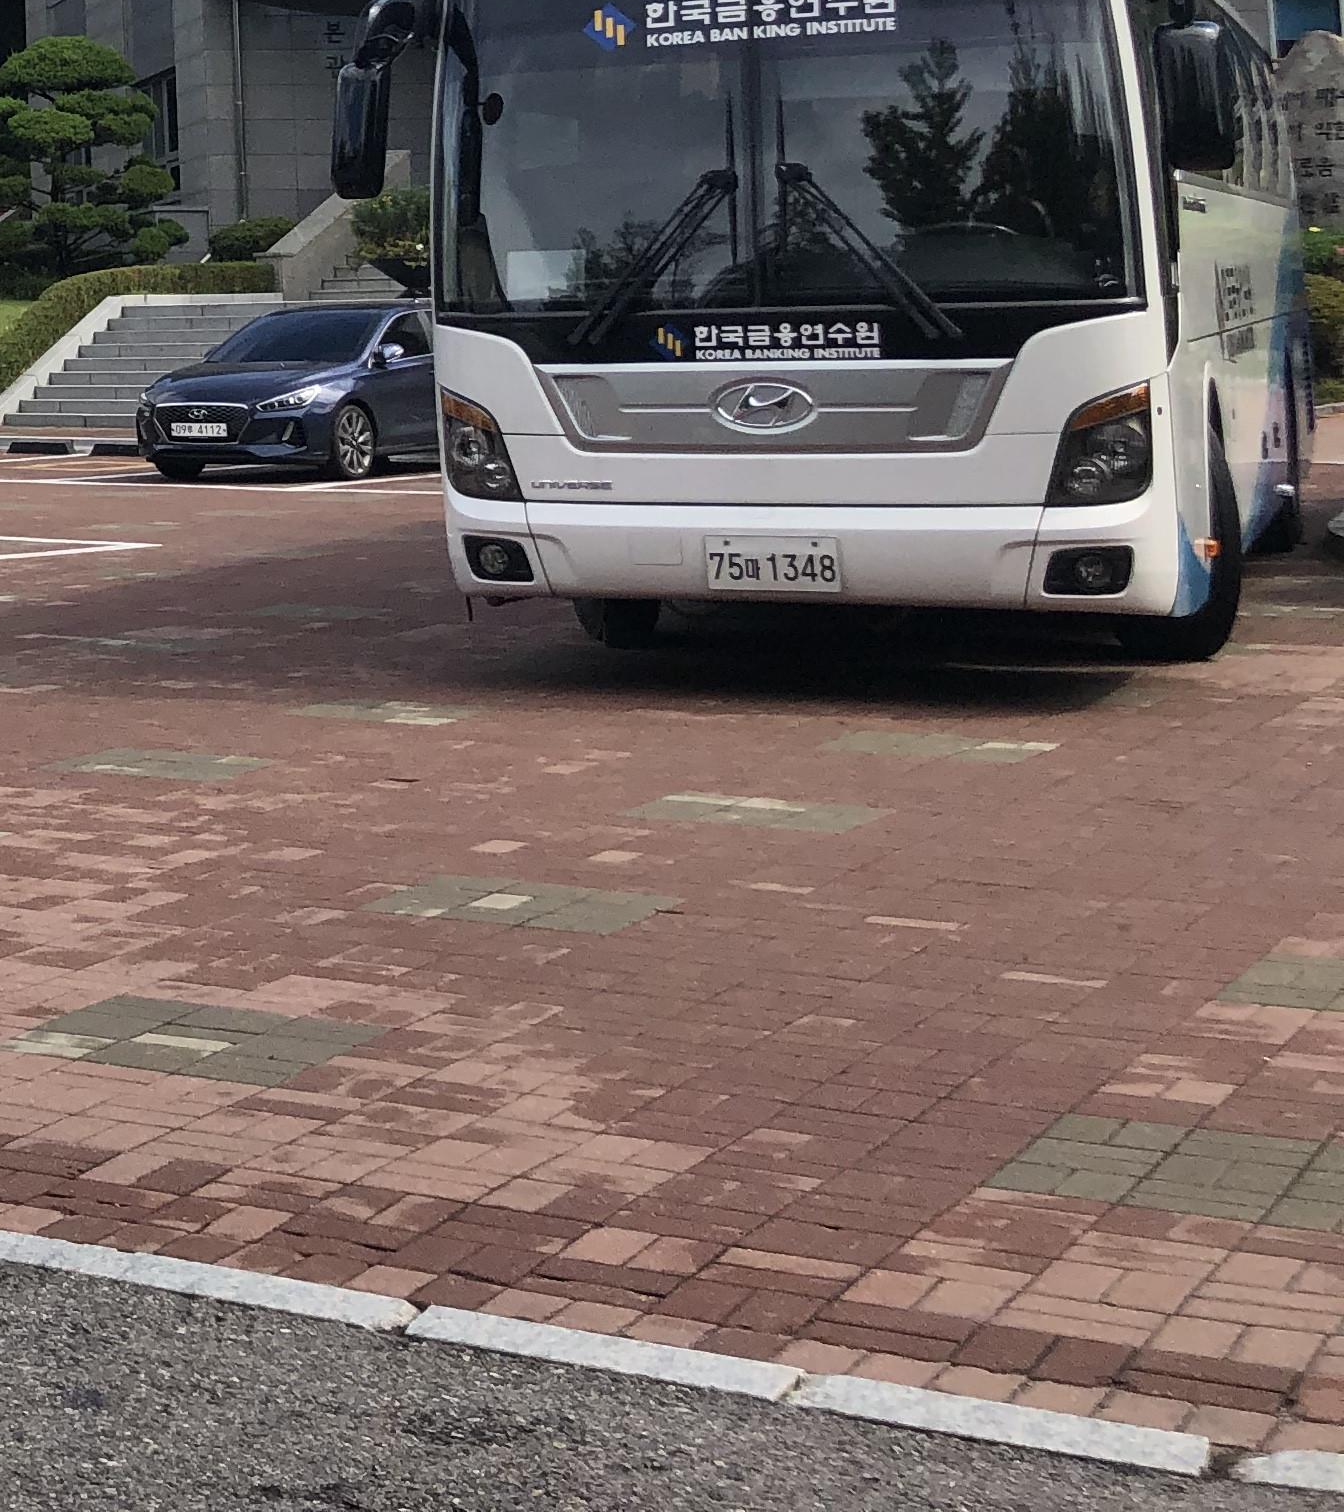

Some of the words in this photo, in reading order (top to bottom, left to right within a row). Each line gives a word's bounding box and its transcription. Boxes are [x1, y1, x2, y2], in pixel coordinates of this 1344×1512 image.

[646, 33, 705, 47] KOREA
[806, 16, 896, 36] INSTITUTE
[693, 322, 881, 347] 한국금융연수원
[695, 348, 742, 360] KOREA
[746, 347, 811, 360] BANKING
[814, 347, 881, 358] INSTITUTE
[709, 552, 761, 581] 75마
[766, 553, 836, 583] 1348
